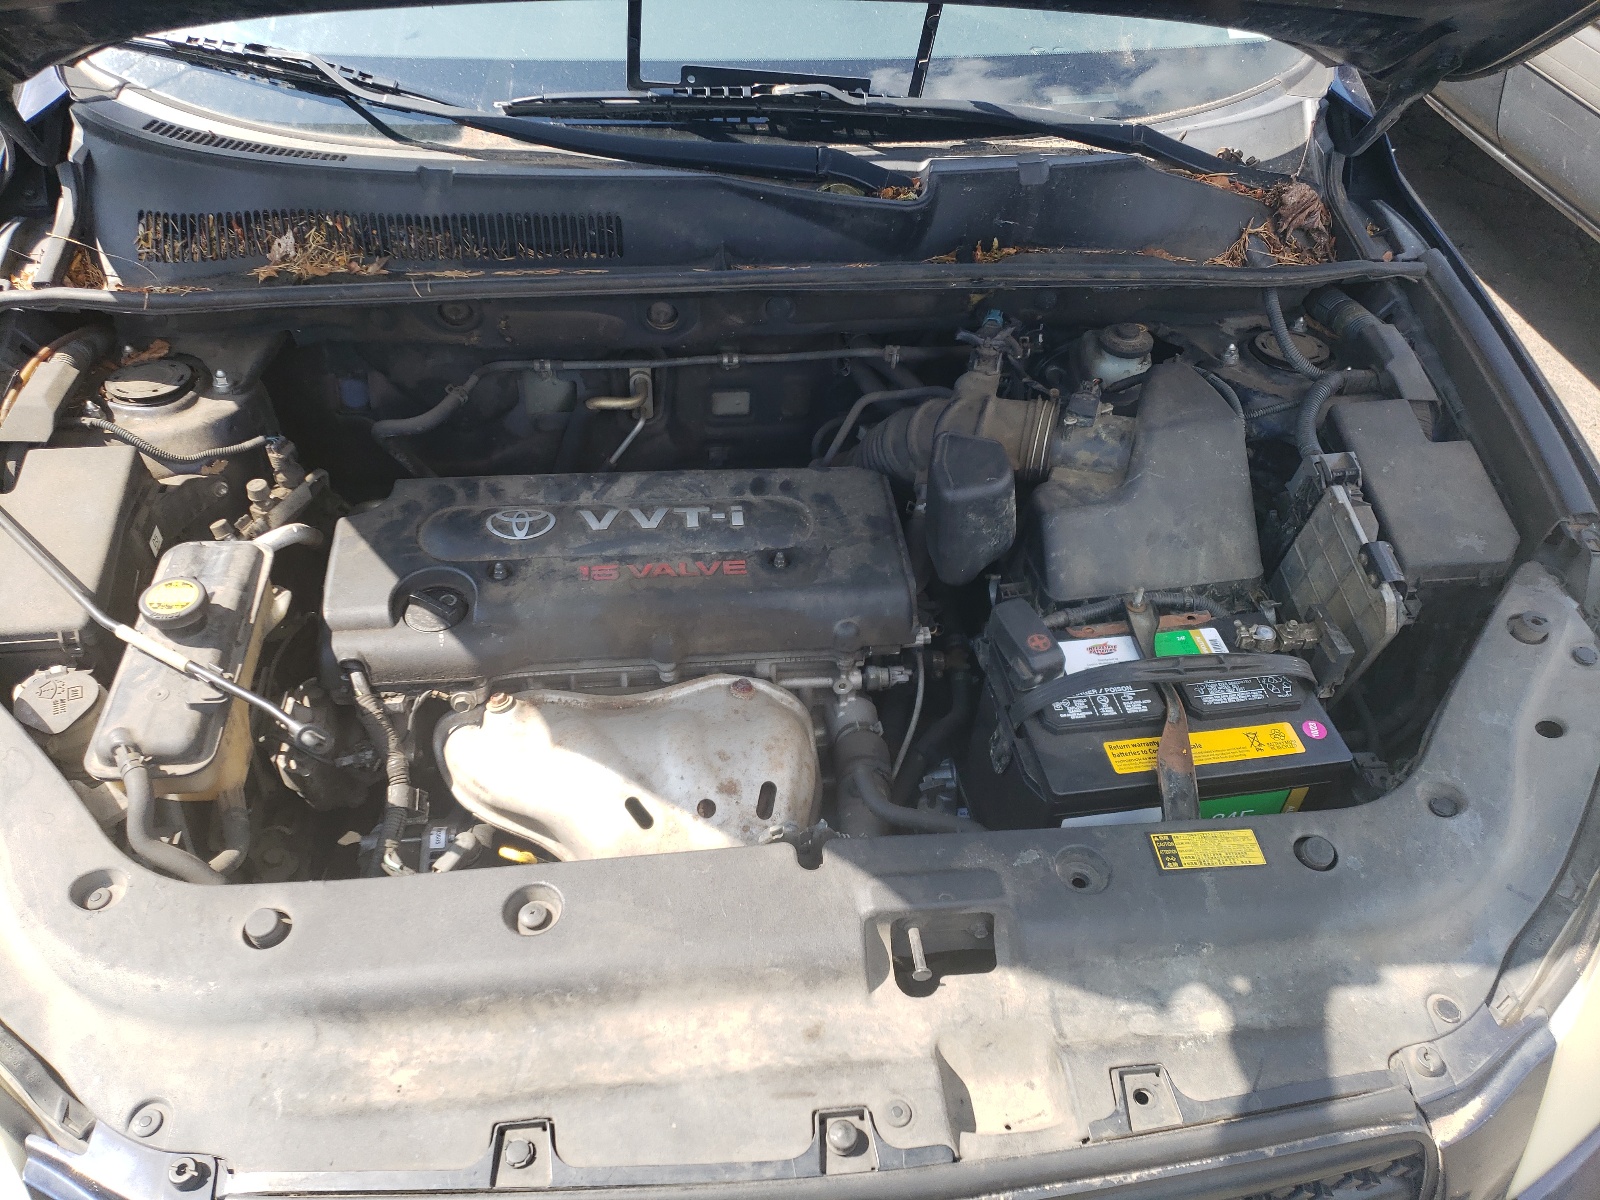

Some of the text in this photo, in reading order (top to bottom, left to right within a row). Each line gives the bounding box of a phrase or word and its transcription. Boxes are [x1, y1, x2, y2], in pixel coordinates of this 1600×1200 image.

[579, 505, 745, 531] VVT-i
[626, 560, 748, 579] VALVE
[1104, 685, 1133, 694] POISON
[1108, 740, 1160, 751] Return warranty
[1111, 749, 1141, 758] batteries
